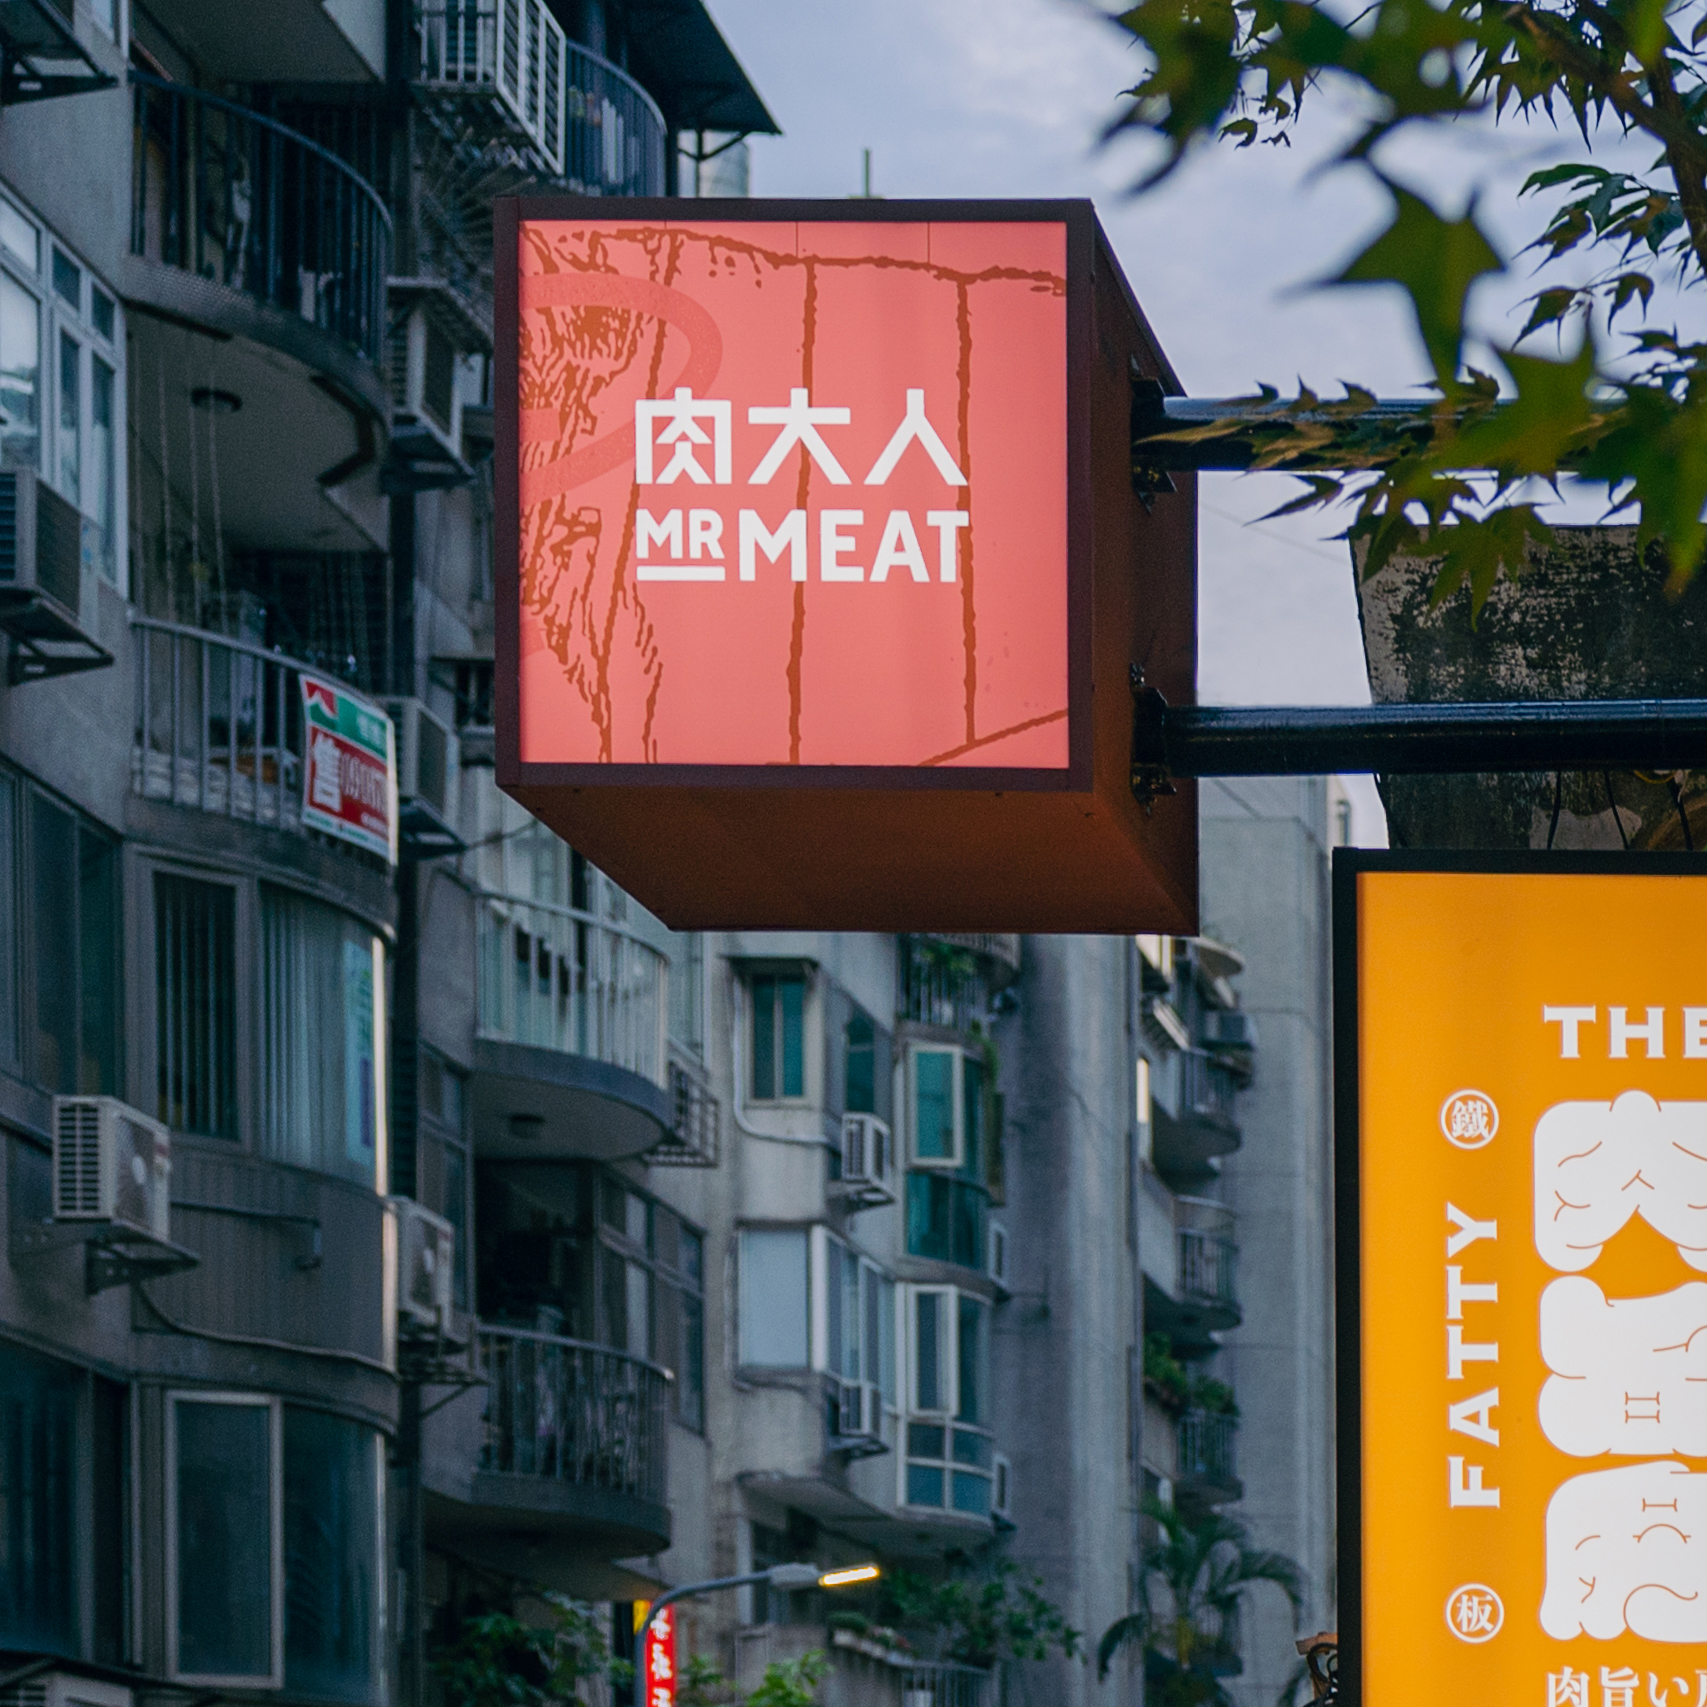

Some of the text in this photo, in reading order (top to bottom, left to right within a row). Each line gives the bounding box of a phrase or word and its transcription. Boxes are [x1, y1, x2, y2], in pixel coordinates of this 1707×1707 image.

[634, 387, 968, 487] 肉大人
[635, 509, 970, 583] MR MEAT
[1446, 1201, 1500, 1509] FATTY
